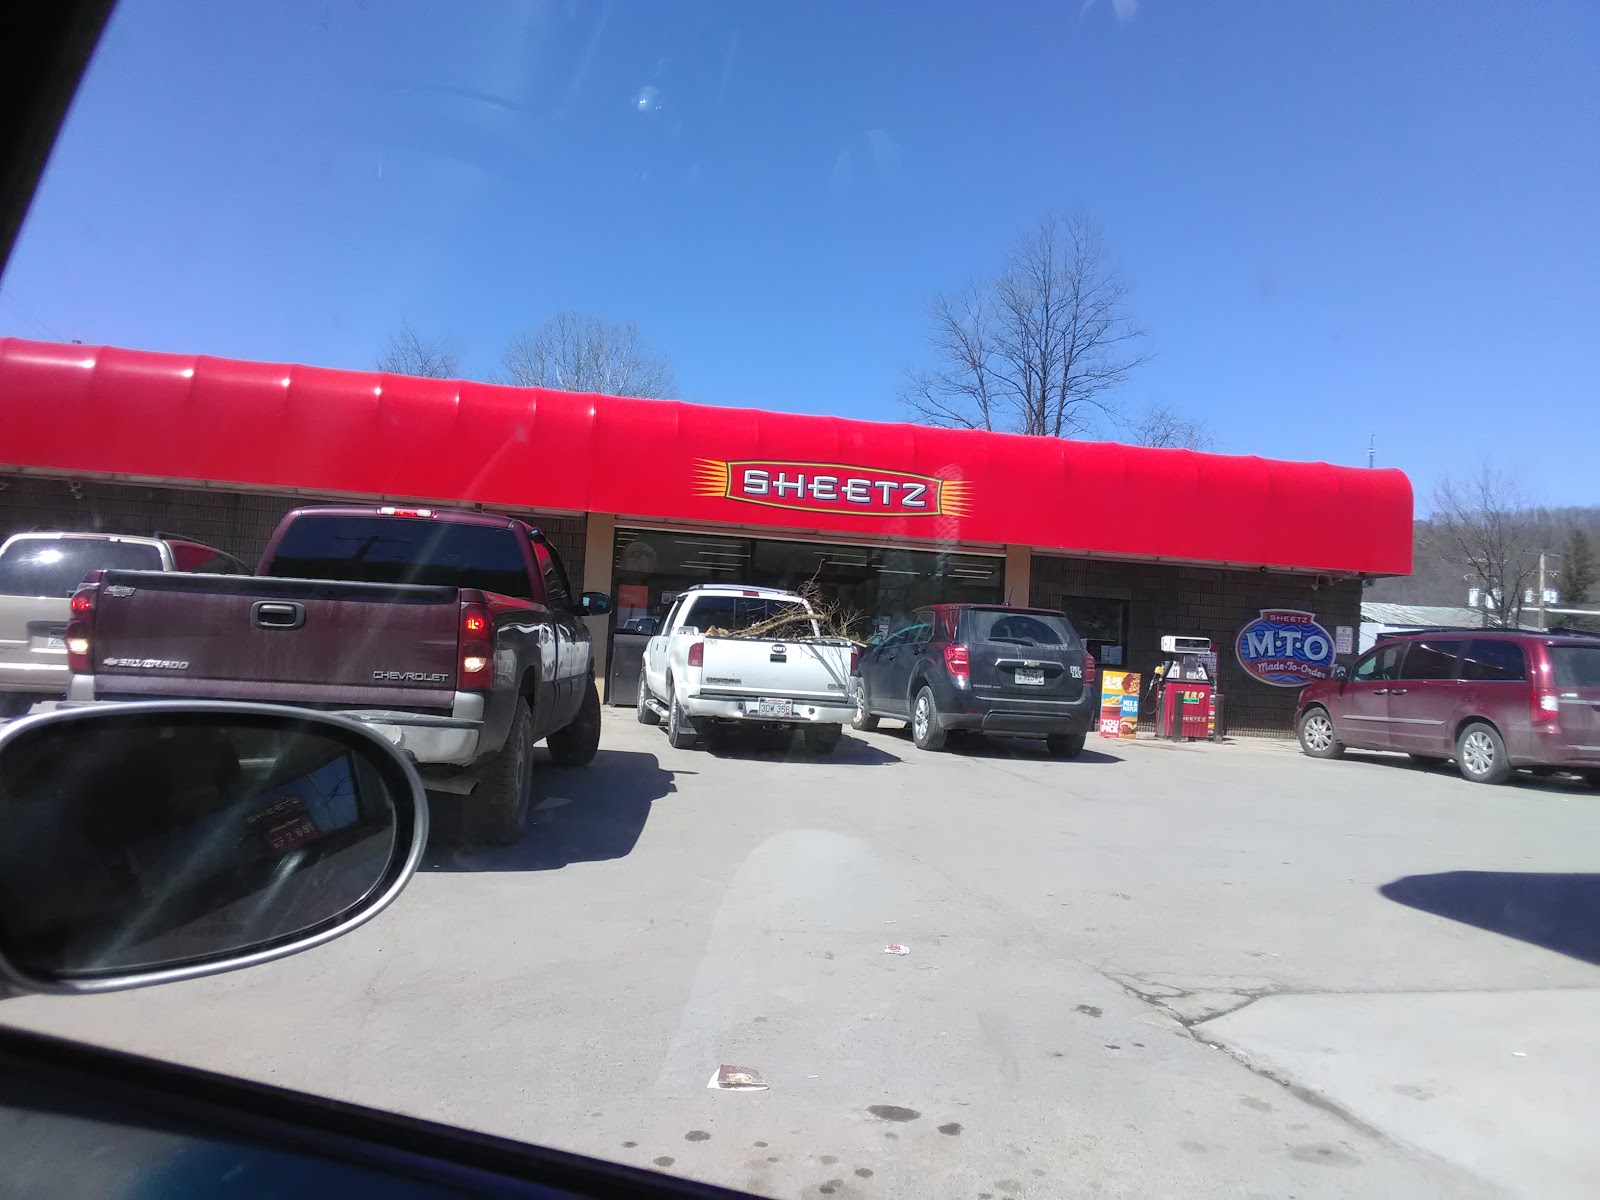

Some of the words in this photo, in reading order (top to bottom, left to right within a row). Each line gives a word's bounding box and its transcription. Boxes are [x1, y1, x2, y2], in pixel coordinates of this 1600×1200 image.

[743, 469, 927, 508] SHEETZ
[1269, 614, 1308, 624] SHEETZ
[118, 658, 190, 669] SILVERADO
[373, 670, 449, 682] CHEVROLET
[1102, 718, 1119, 726] YOU
[1101, 725, 1119, 734] PICK
